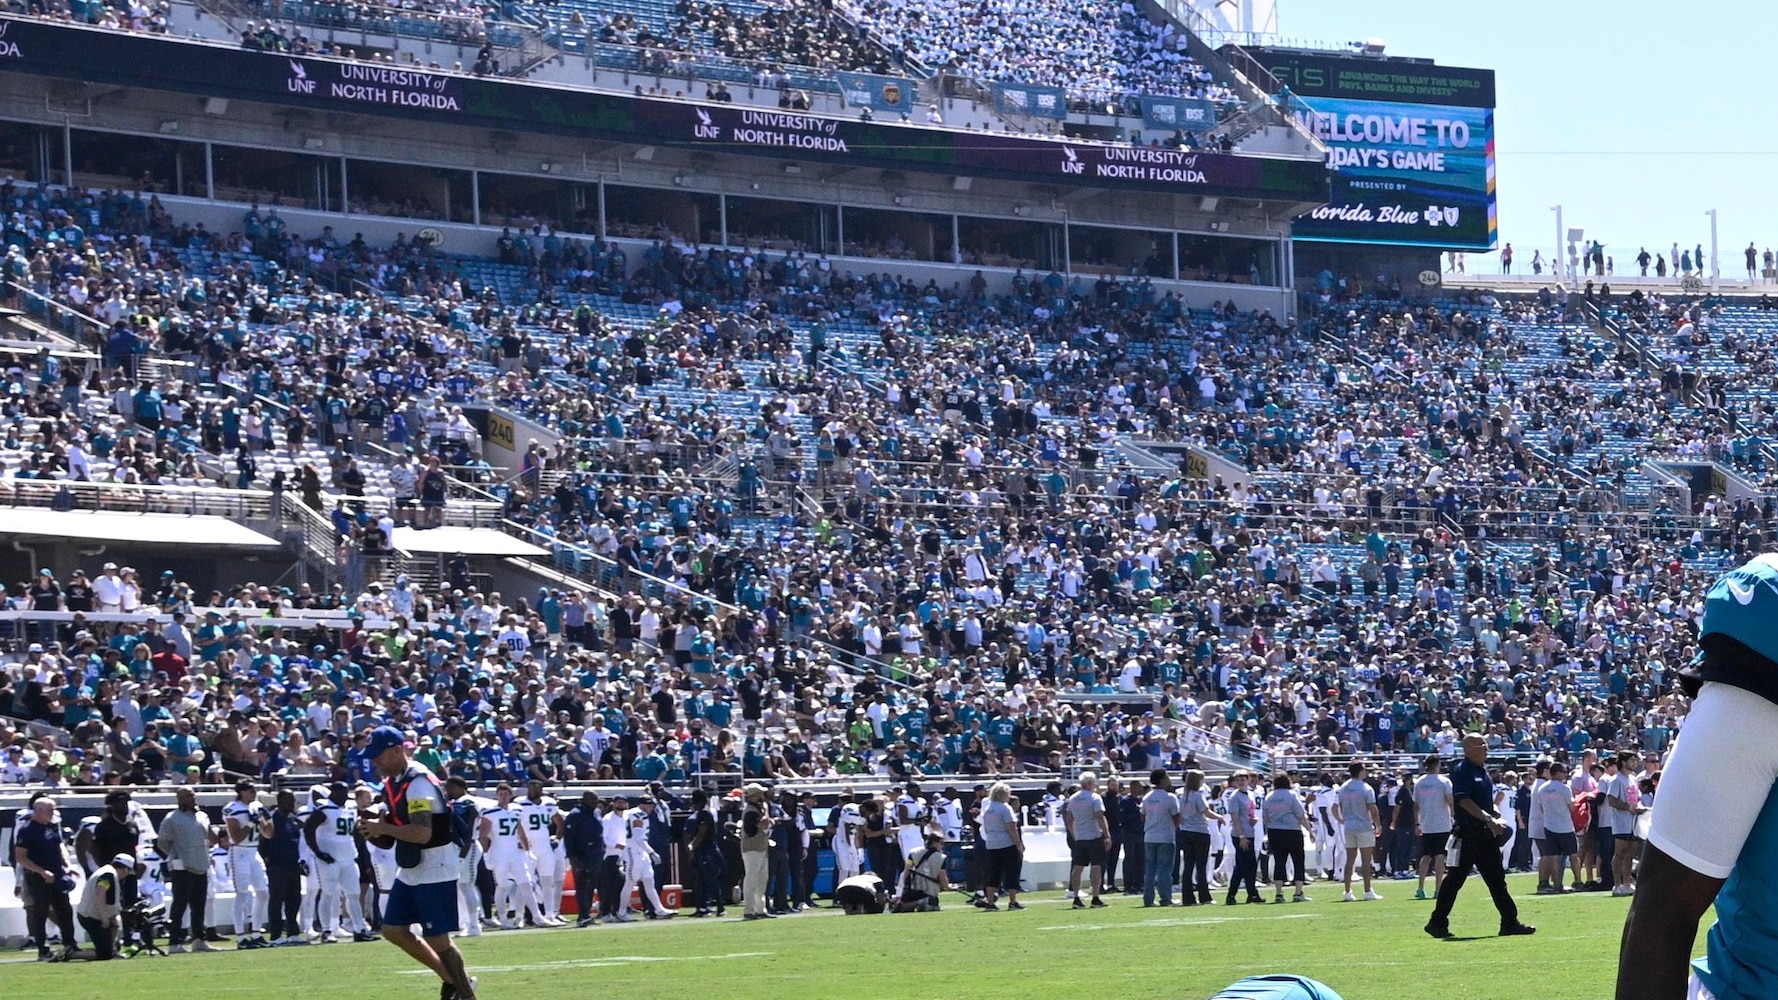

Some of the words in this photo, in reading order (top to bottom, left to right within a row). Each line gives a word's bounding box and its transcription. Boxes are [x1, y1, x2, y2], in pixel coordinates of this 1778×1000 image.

[287, 78, 317, 94] UNF
[341, 64, 432, 88] UNIVERSITY
[433, 77, 449, 93] of
[1338, 71, 1390, 83] ADVANCING
[1391, 74, 1408, 84] THE
[1408, 75, 1431, 86] WAY
[1431, 77, 1448, 87] THE
[1449, 78, 1481, 89] WORLD
[1365, 82, 1395, 93] BANKS
[1395, 84, 1415, 94] AND
[331, 83, 387, 103] NORTH
[391, 89, 459, 111] FLORIDA
[694, 125, 721, 139] UNF
[742, 110, 825, 132] UNIVERSITY
[825, 121, 839, 136] of
[733, 128, 784, 146] NORTH
[788, 133, 848, 152] FLORIDA
[1431, 119, 1470, 149] TO
[1104, 147, 1184, 165] UNIVERSITY
[1184, 154, 1199, 168] of
[1392, 151, 1445, 172] GAME
[1061, 161, 1086, 175] UNF
[1096, 164, 1145, 179] NORTH
[1149, 167, 1207, 184] FLORIDA
[1350, 180, 1395, 191] PRESENTED
[1396, 183, 1407, 191] BY
[1376, 204, 1419, 224] Blue
[1421, 273, 1437, 283] 244
[1684, 279, 1700, 289] 245
[490, 422, 514, 444] 240
[1188, 453, 1207, 476] 242
[498, 817, 520, 836] 57
[529, 811, 551, 831] 94
